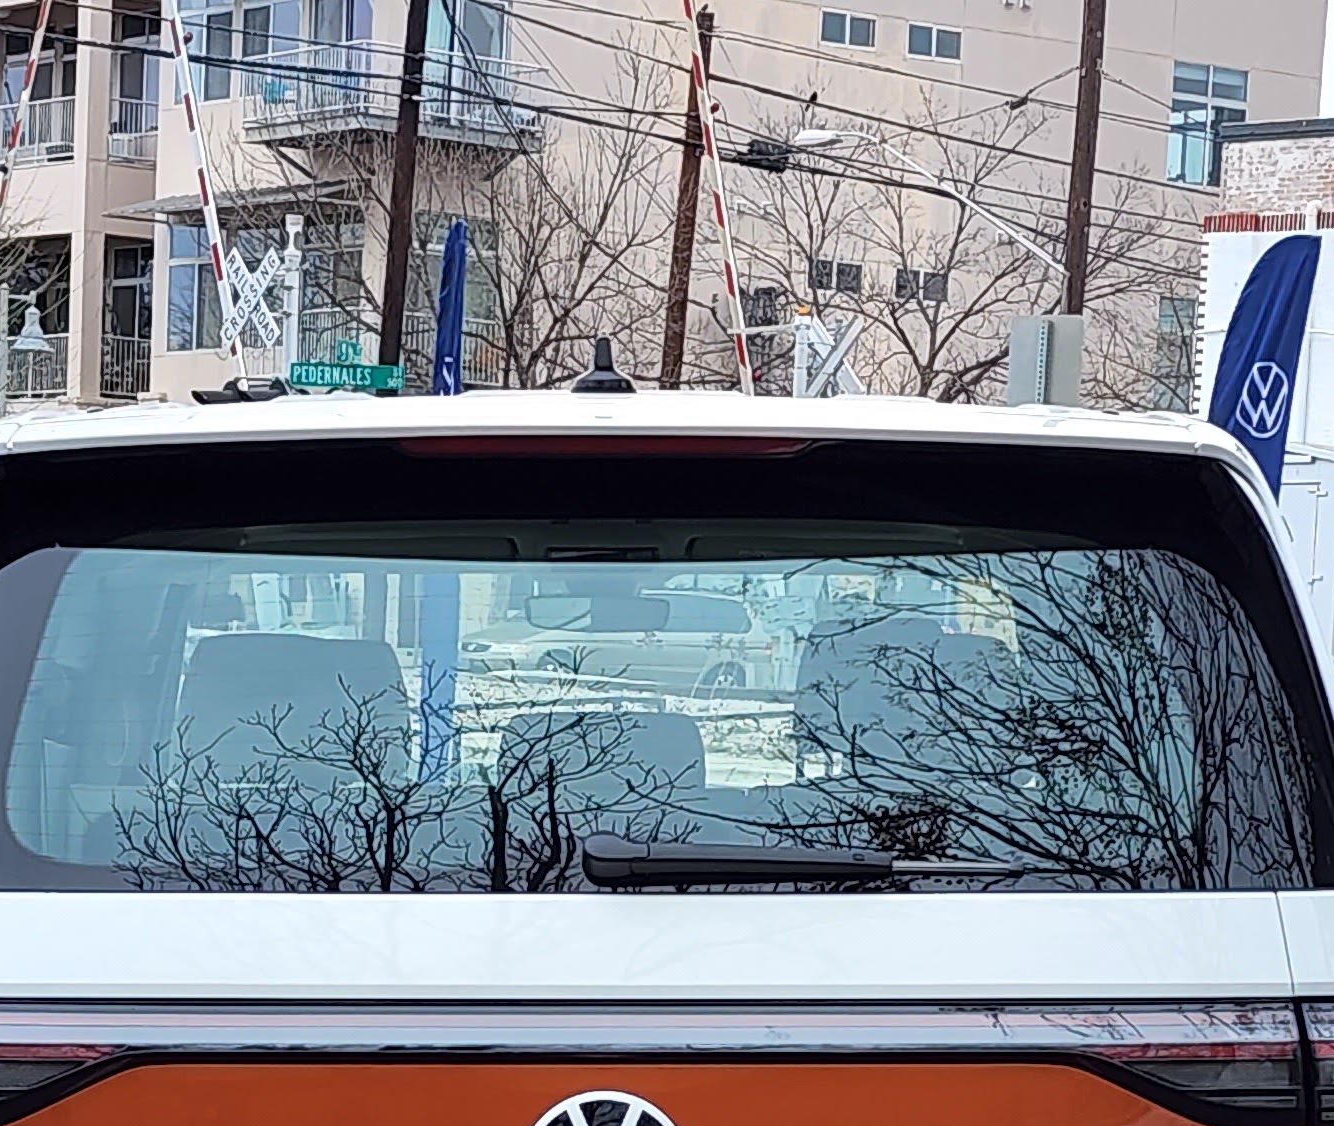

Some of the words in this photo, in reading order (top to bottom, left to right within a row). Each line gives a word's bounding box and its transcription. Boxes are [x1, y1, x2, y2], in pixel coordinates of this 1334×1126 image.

[224, 254, 276, 342] CROSSING
[227, 253, 248, 295] RAIL
[254, 301, 275, 342] ROAD
[292, 365, 372, 386] PEDERNALES
